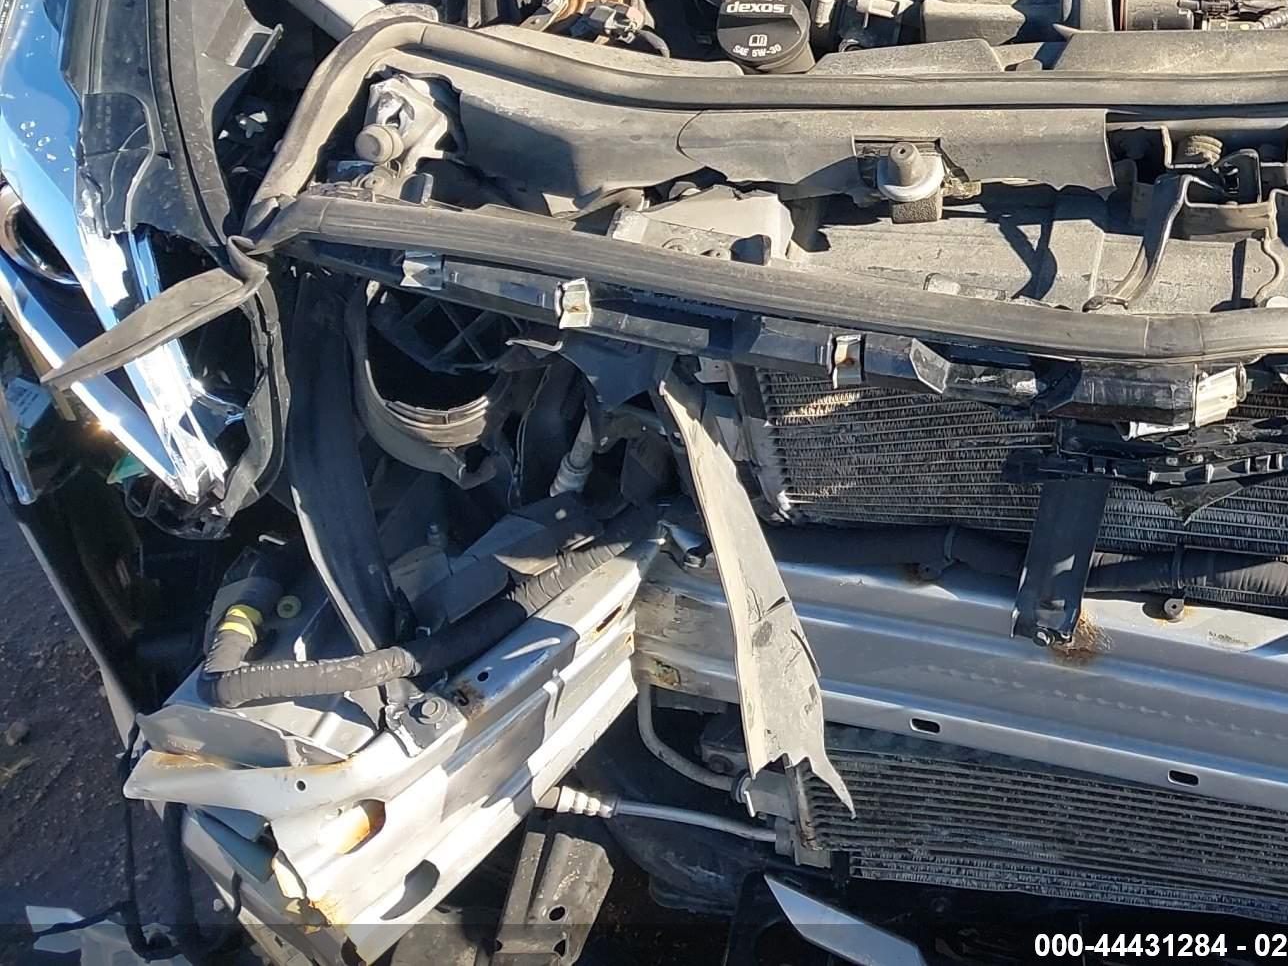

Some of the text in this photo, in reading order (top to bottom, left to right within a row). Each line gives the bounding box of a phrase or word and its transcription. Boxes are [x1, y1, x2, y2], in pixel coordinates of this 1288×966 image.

[726, 0, 787, 14] dexos
[732, 43, 782, 58] SAE 5W-30
